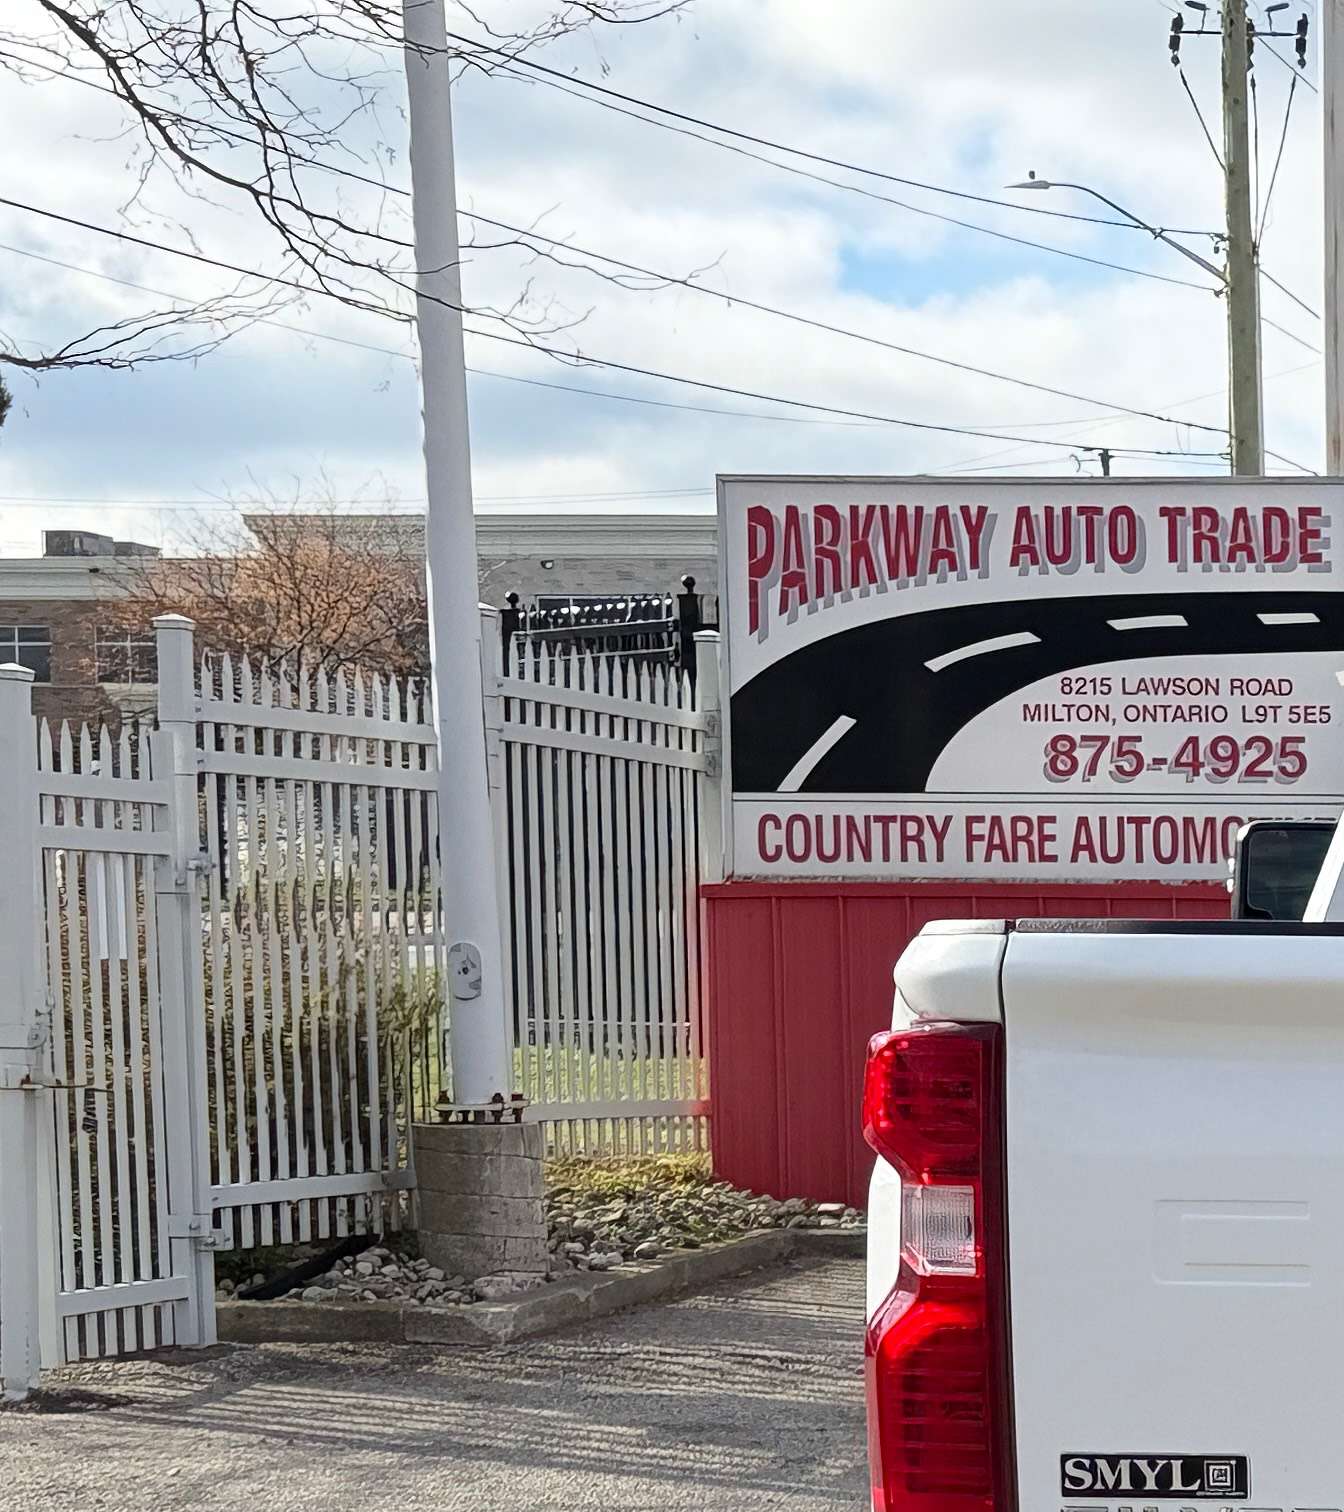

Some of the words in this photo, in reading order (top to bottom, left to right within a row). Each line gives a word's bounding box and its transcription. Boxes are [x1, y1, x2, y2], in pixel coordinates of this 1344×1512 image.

[747, 504, 990, 636] PARKWAY
[1009, 505, 1138, 567] AUTO
[1159, 505, 1324, 565] TRADE
[1060, 676, 1112, 696] 8215
[1121, 677, 1220, 697] LAWSON
[1230, 678, 1293, 697] ROAD
[1022, 703, 1117, 726] MILTON,
[1123, 704, 1229, 724] ONTARIO
[1241, 705, 1282, 724] L9T
[1288, 705, 1332, 724] 5E5
[1047, 733, 1308, 779] 875-4925
[757, 813, 952, 864] COUNTRY
[964, 815, 1058, 864] FARE
[1070, 814, 1337, 865] AUTOMO
[1063, 1457, 1201, 1491] SMYL
